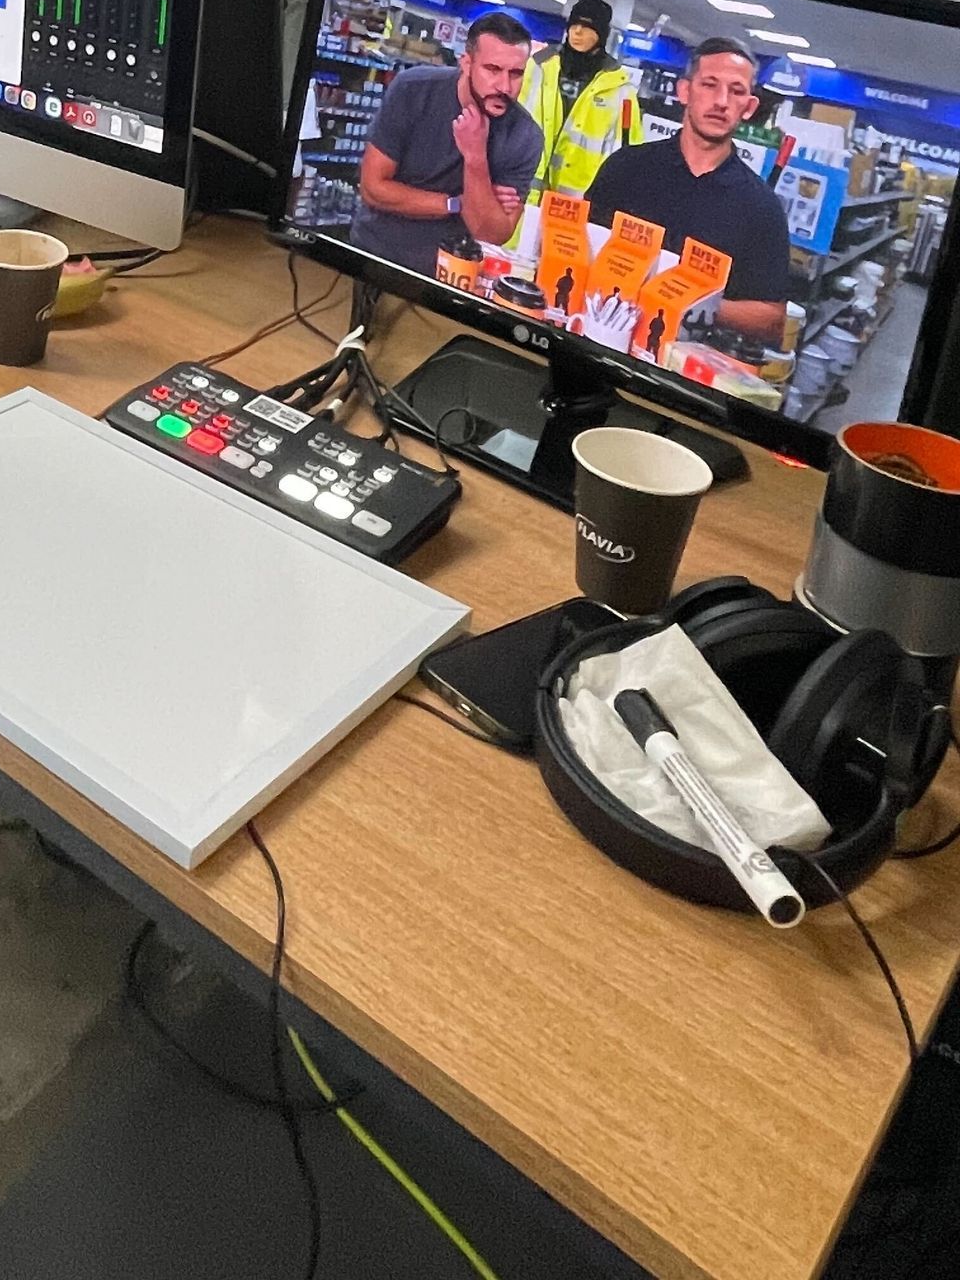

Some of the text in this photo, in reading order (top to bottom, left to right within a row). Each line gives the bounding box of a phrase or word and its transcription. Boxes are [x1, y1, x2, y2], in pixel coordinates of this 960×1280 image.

[865, 86, 929, 110] WELCOME
[438, 264, 471, 291] BIG
[531, 333, 549, 349] LG
[578, 521, 624, 557] FLAVIA
